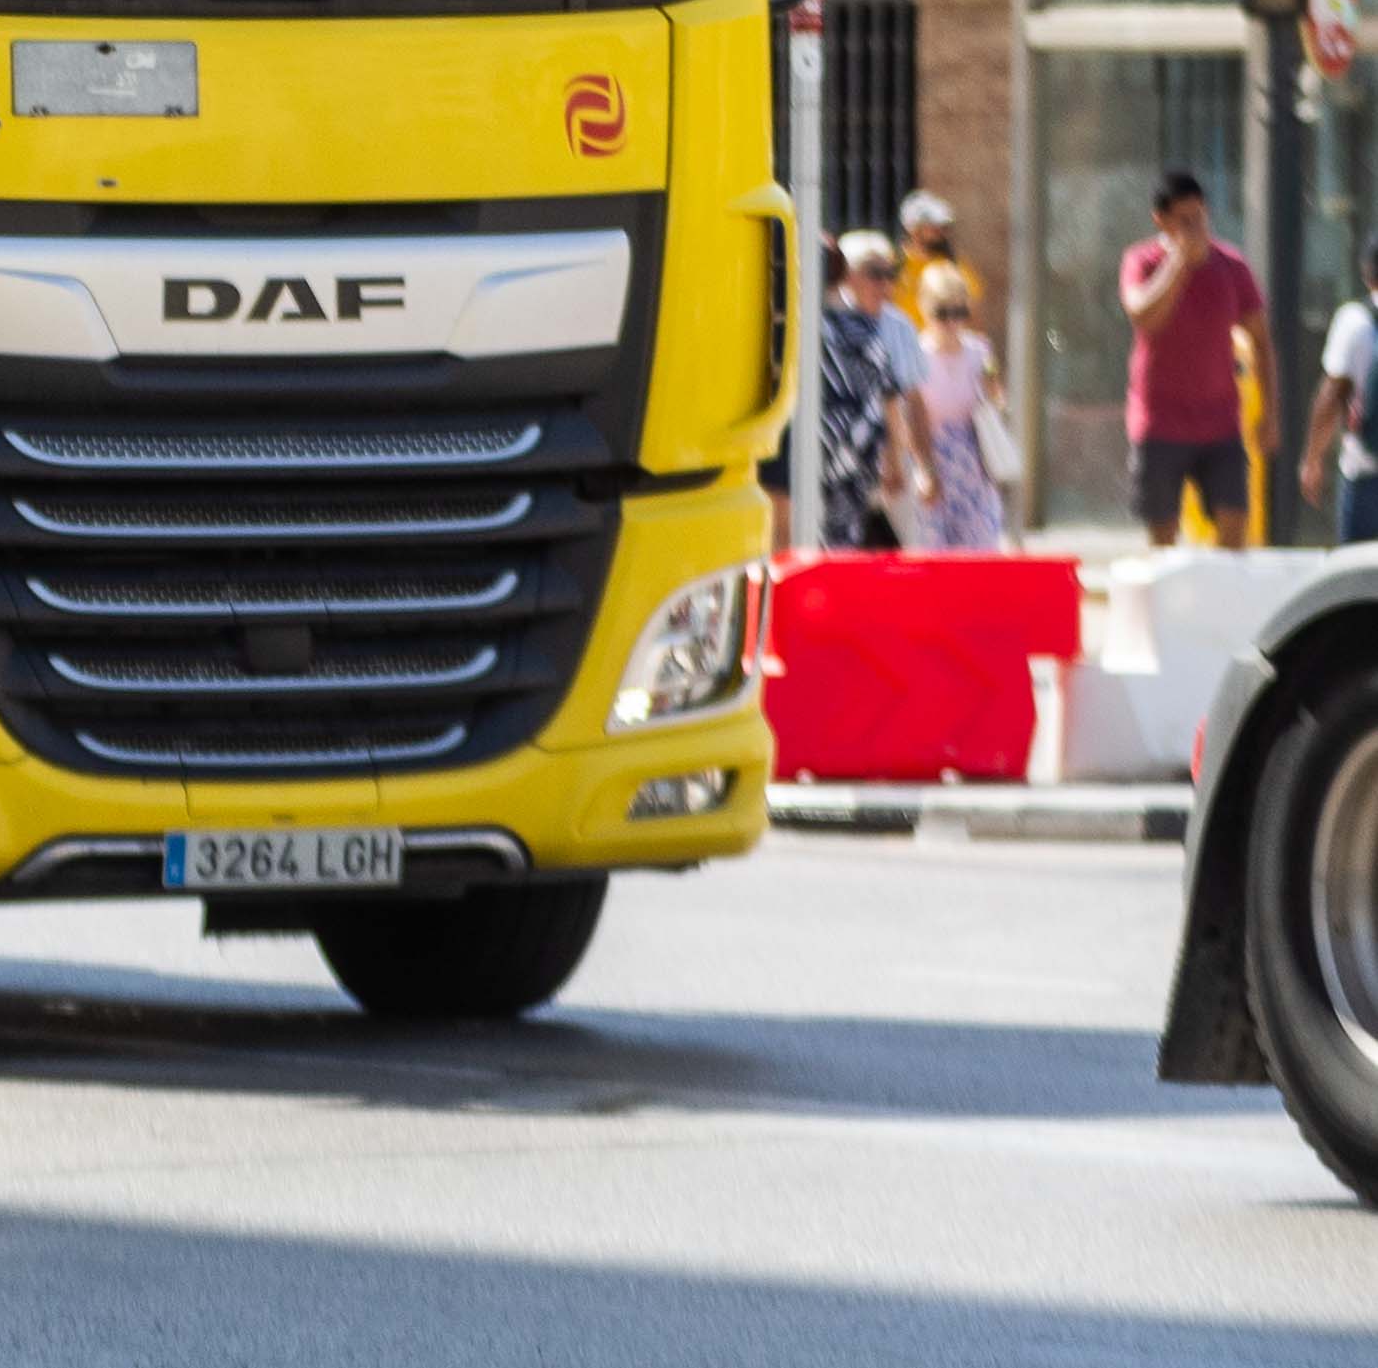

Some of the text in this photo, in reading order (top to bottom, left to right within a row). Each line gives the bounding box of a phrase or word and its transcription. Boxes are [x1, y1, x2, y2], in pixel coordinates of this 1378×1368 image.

[163, 276, 405, 321] DAF
[196, 835, 394, 881] 3264 LGH
